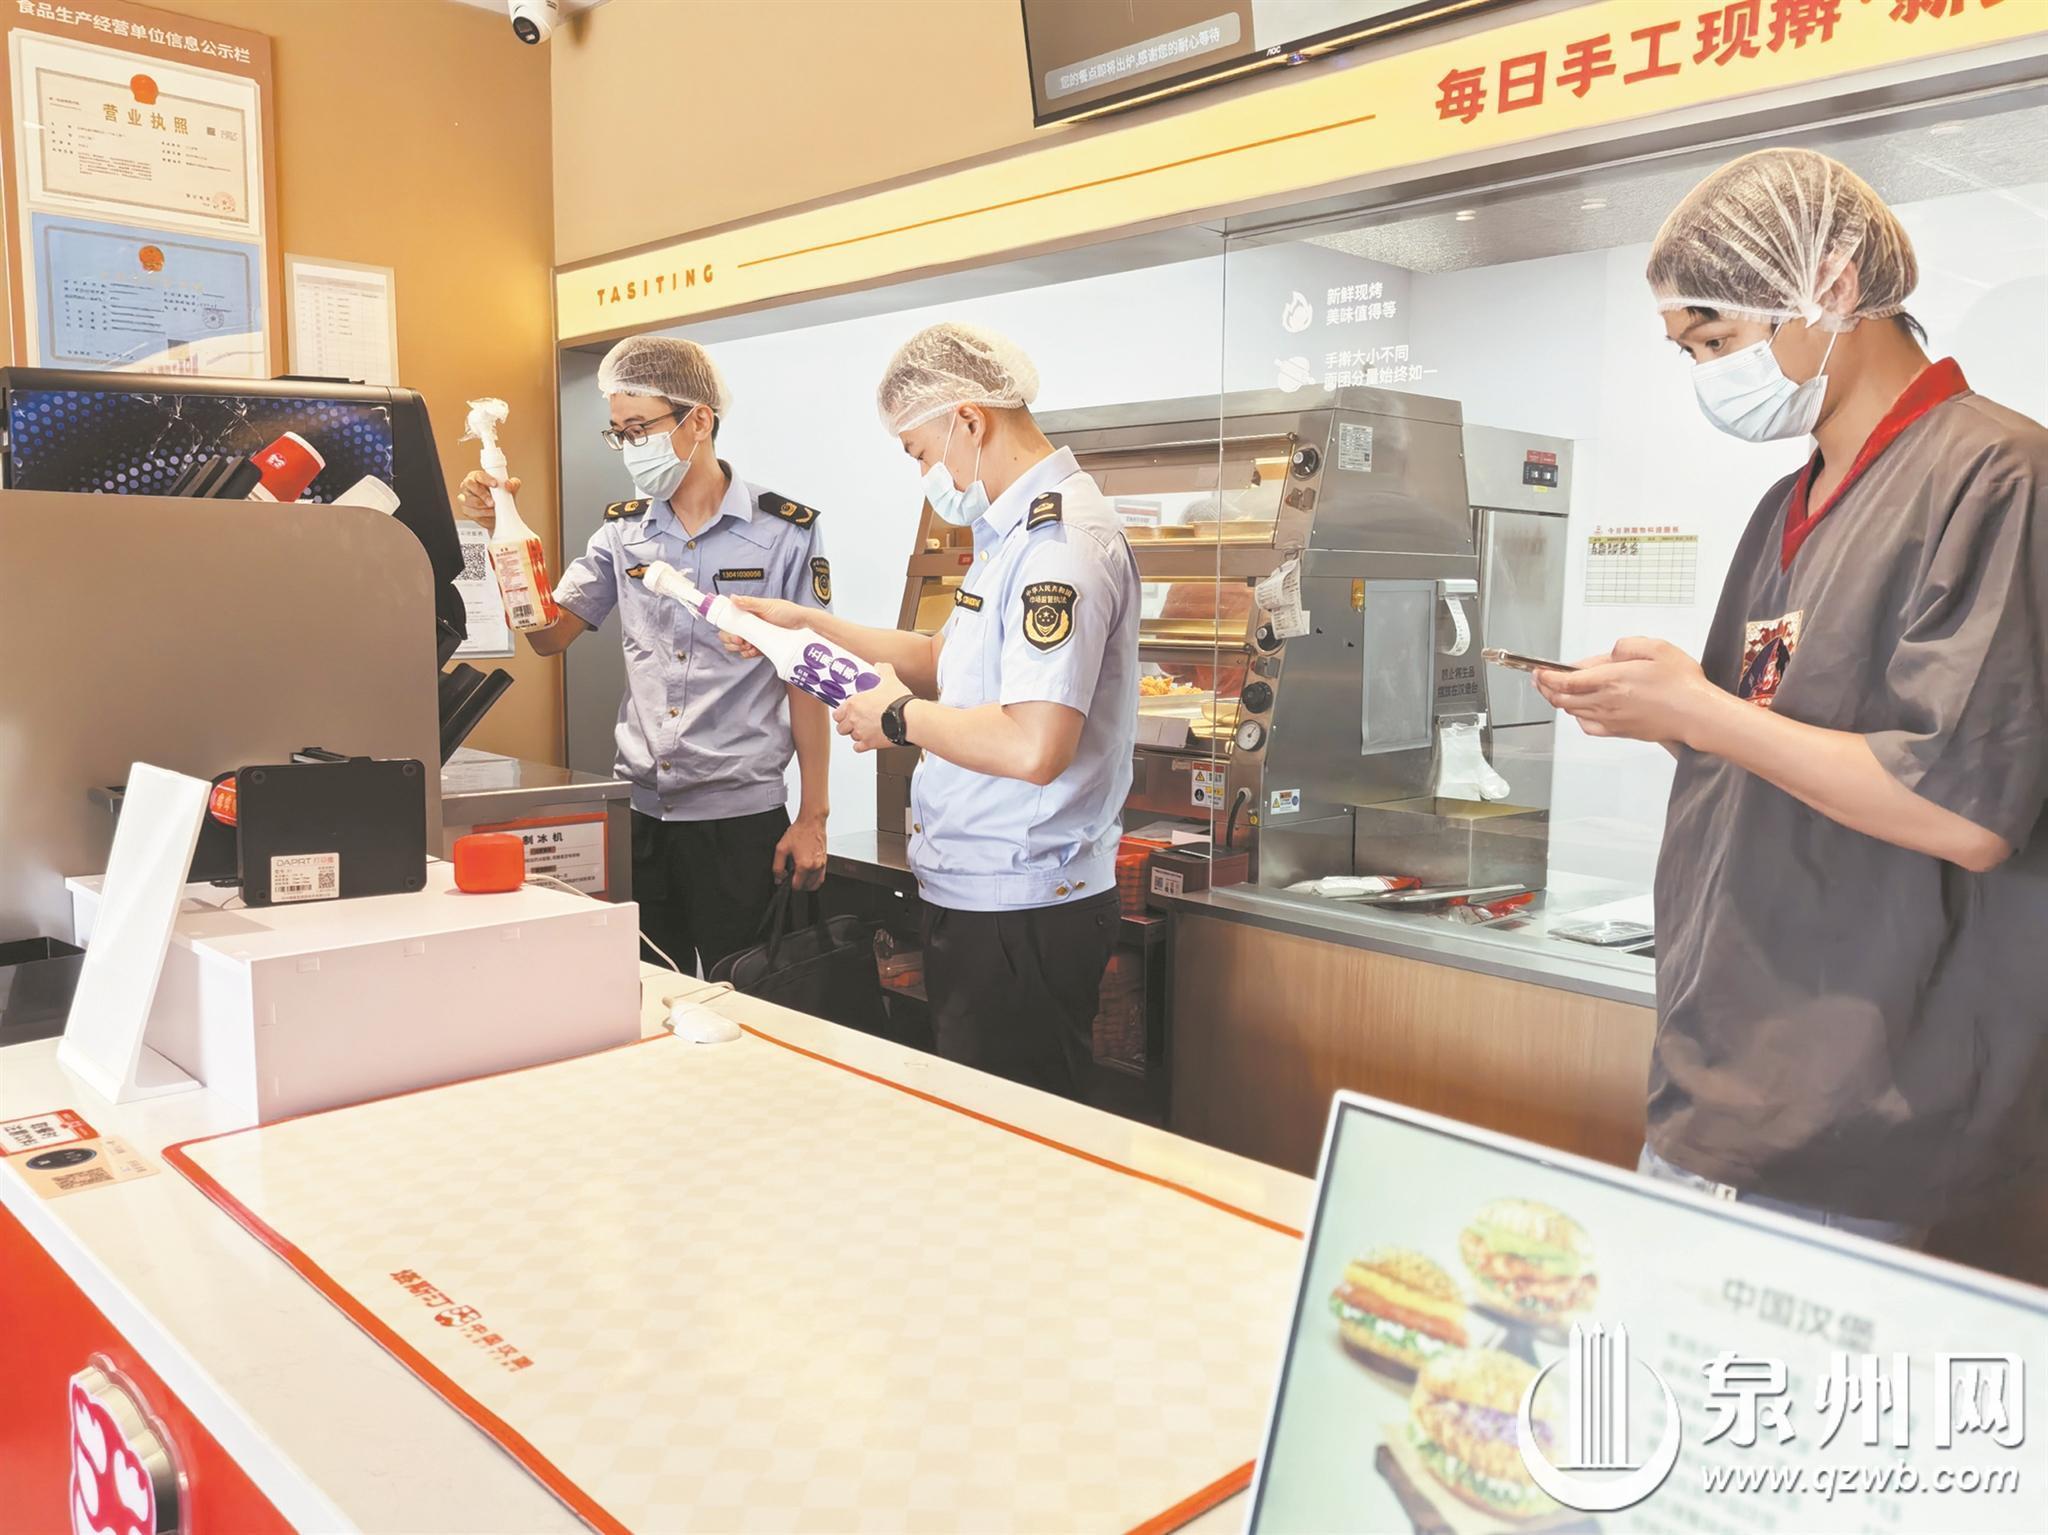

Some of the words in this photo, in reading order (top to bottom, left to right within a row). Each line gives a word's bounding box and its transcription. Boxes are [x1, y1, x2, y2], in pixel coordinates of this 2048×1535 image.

[16, 0, 251, 64] 食品生产经营单位信息公示栏
[102, 103, 189, 136] 营业执照
[597, 264, 714, 306] TASITING
[1326, 282, 1384, 306] 新鲜现烤
[1325, 301, 1397, 326] 美味值得等
[522, 831, 564, 846] 制冰机
[1722, 1277, 1875, 1352] 中国汉堡
